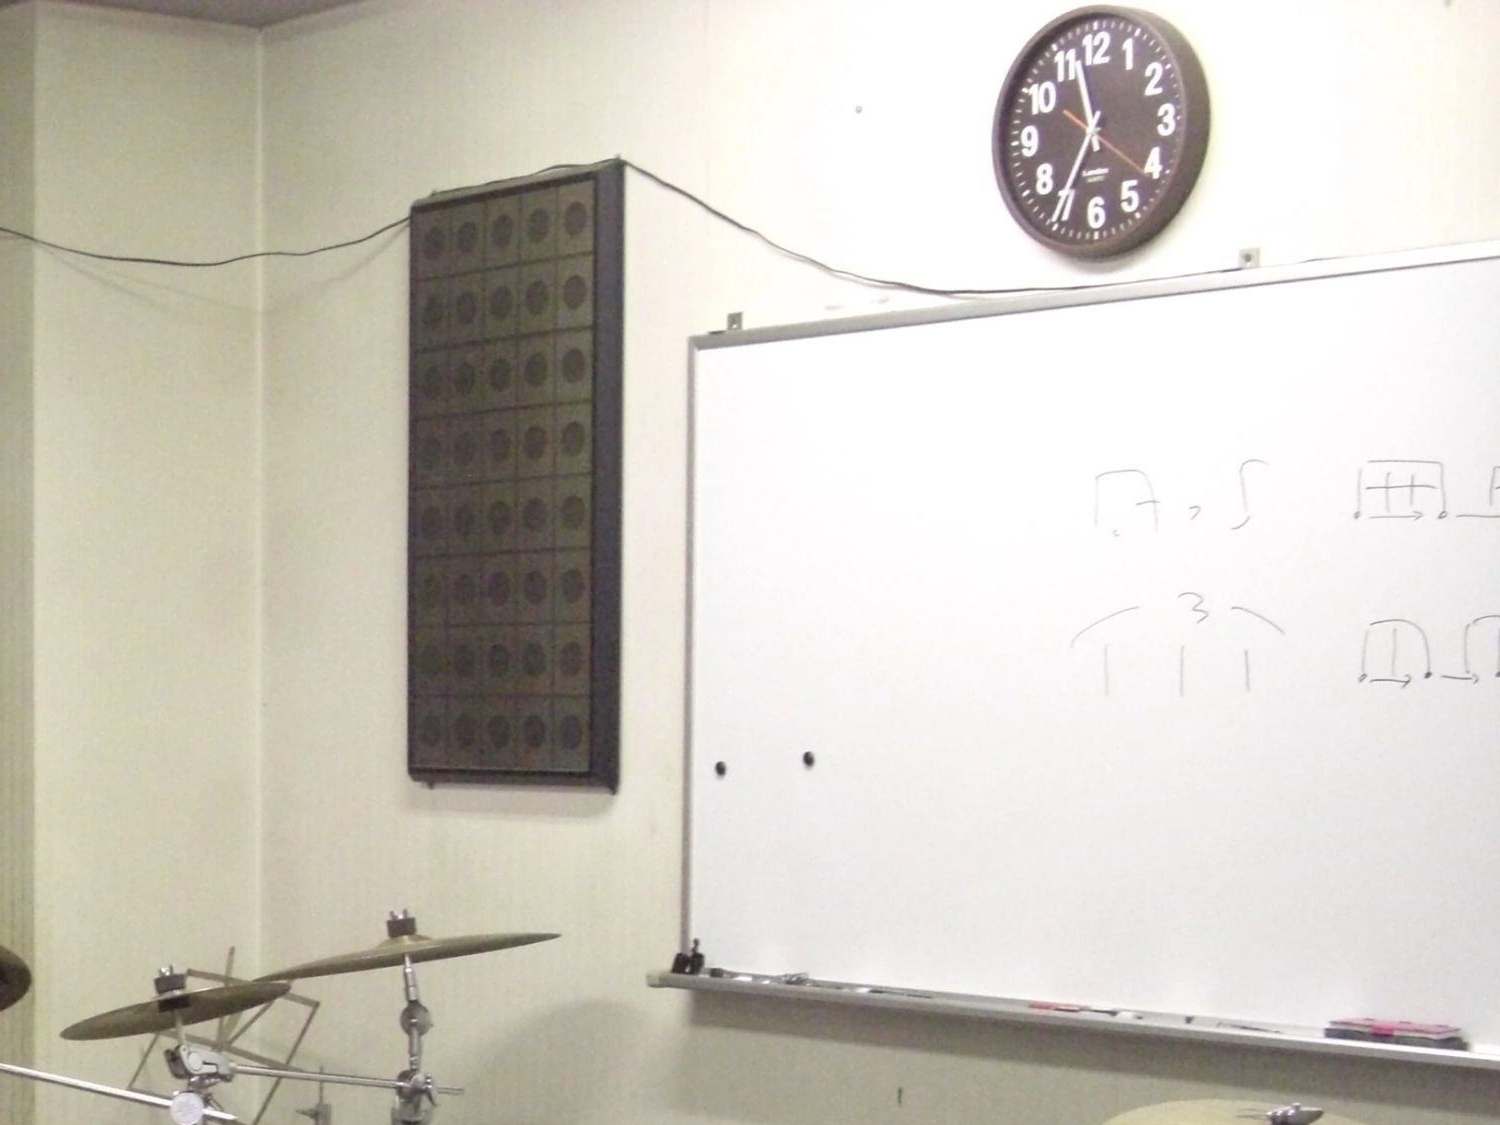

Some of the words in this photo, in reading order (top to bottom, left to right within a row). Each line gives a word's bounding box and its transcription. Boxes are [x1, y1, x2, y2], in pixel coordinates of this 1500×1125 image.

[1082, 31, 1111, 65] 12
[1122, 38, 1134, 70] 1
[1054, 49, 1077, 82] 11
[1144, 62, 1163, 96] 2
[1028, 81, 1056, 115] 10
[1157, 103, 1176, 136] 3
[1021, 125, 1038, 157] 9
[1036, 163, 1053, 195] 8
[1144, 147, 1162, 179] 4
[1056, 188, 1075, 221] 7
[1121, 180, 1139, 212] 5
[1087, 197, 1105, 229] 6
